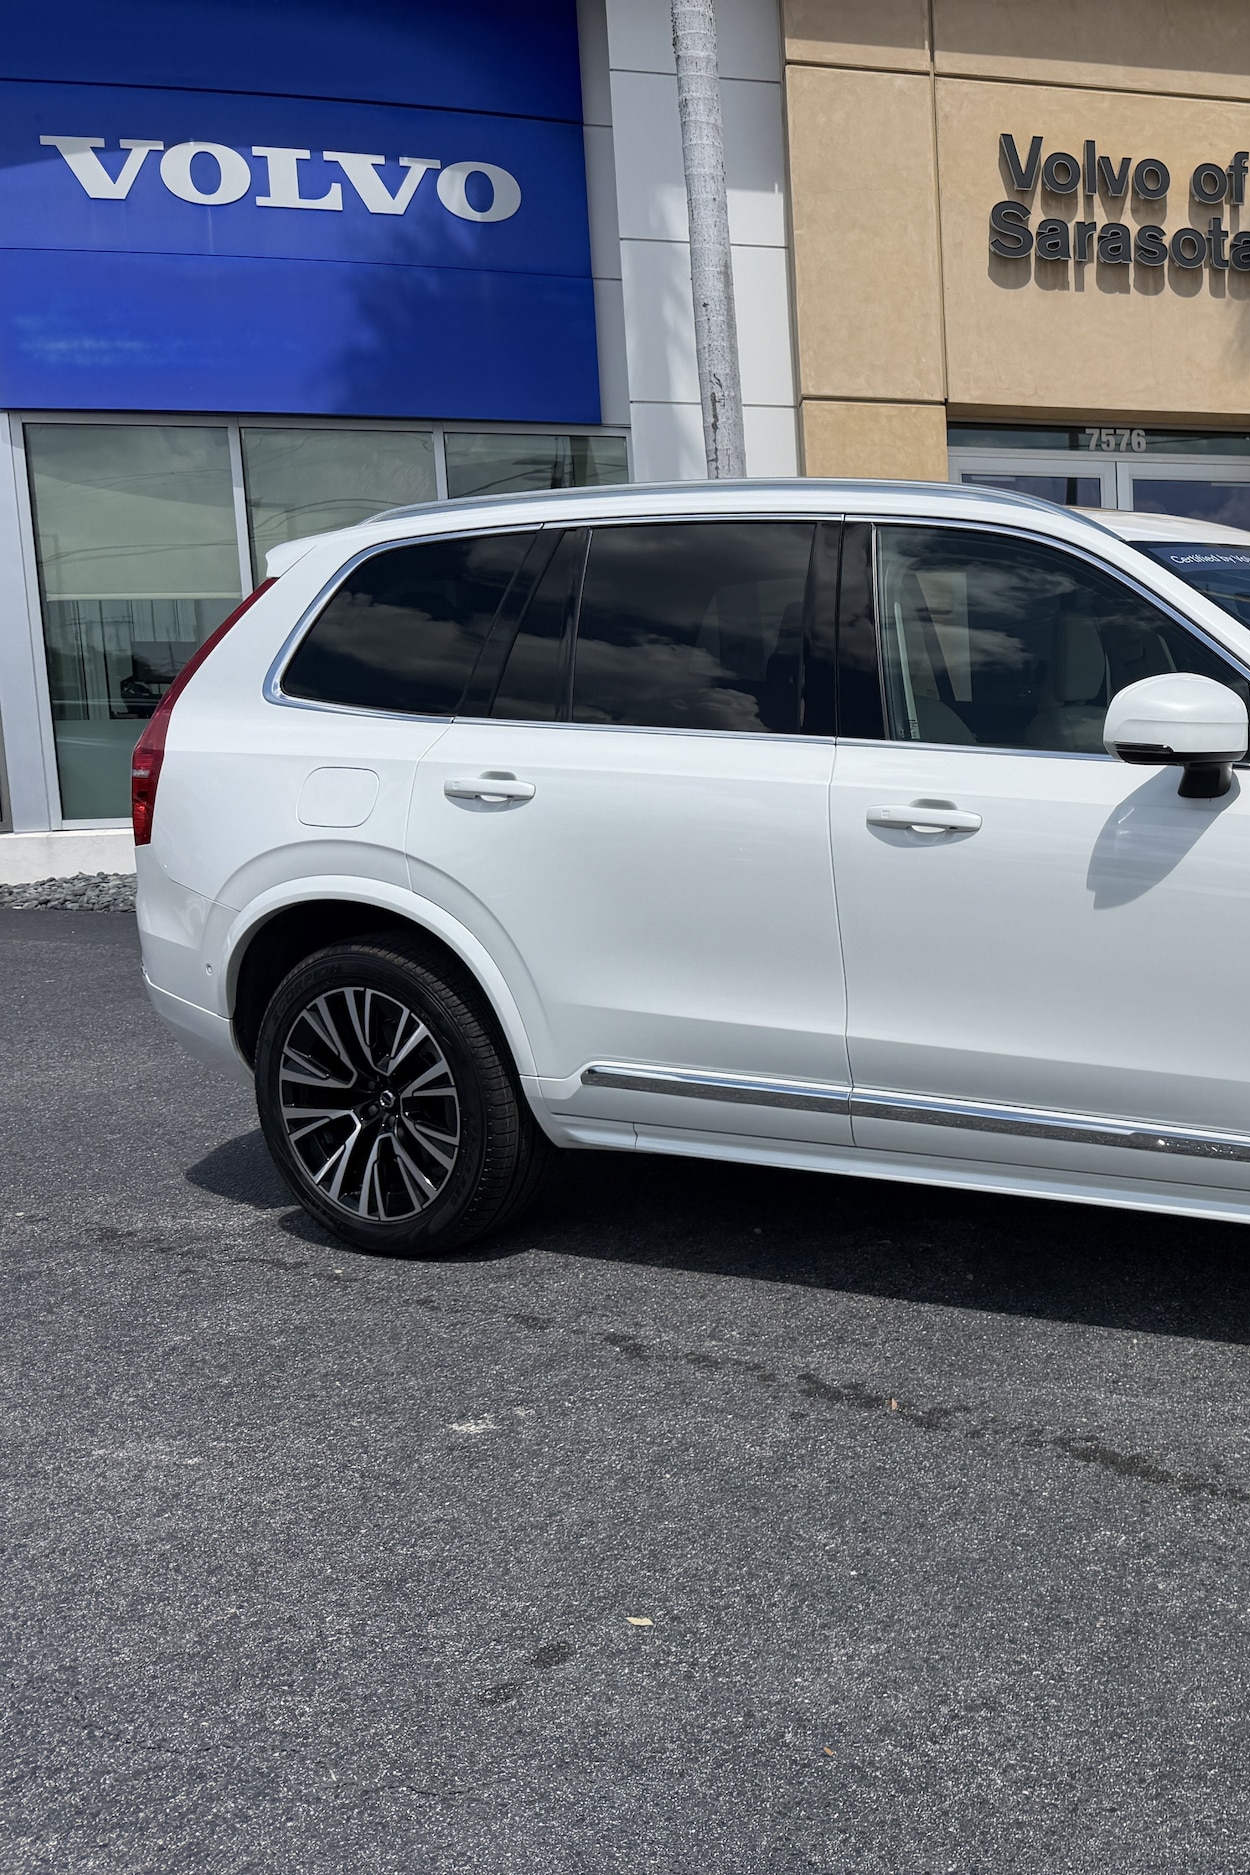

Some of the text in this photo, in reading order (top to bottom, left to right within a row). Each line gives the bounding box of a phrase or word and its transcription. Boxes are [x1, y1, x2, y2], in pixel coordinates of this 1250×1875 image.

[39, 134, 522, 223] VOLVO
[999, 133, 1249, 205] Volvo of
[1085, 427, 1147, 453] 7576
[1170, 554, 1220, 565] Certified
